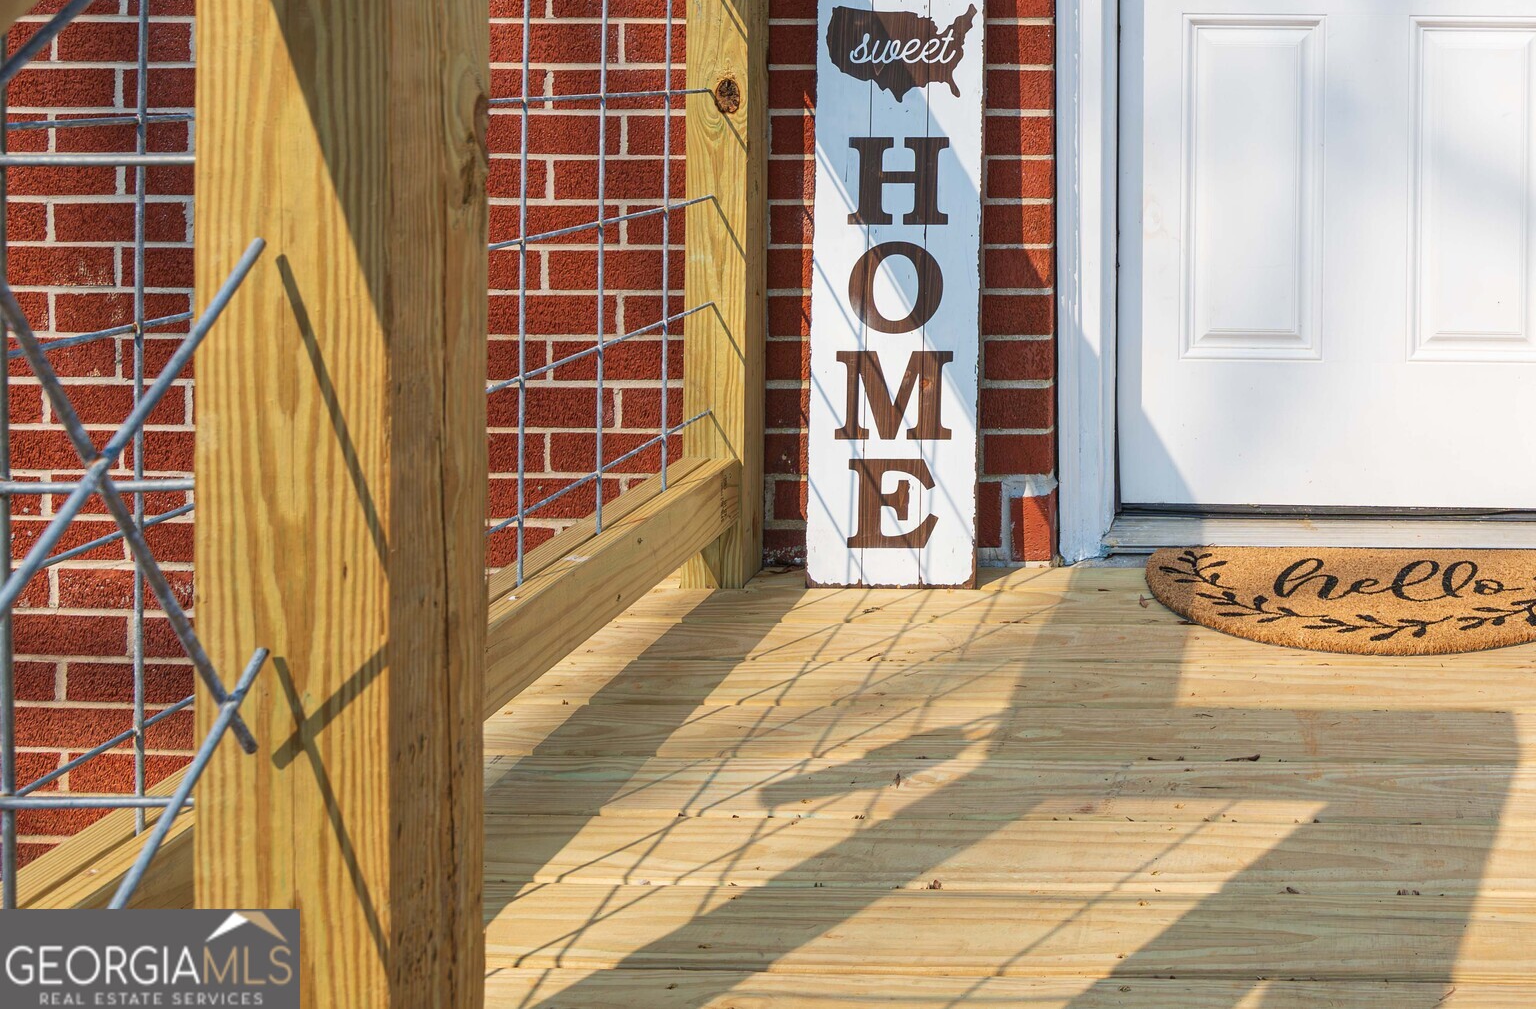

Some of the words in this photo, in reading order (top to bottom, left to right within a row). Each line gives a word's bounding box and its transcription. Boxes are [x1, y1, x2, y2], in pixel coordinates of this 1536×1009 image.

[848, 27, 958, 66] sweet
[833, 136, 954, 548] HOME
[1273, 557, 1525, 602] hello
